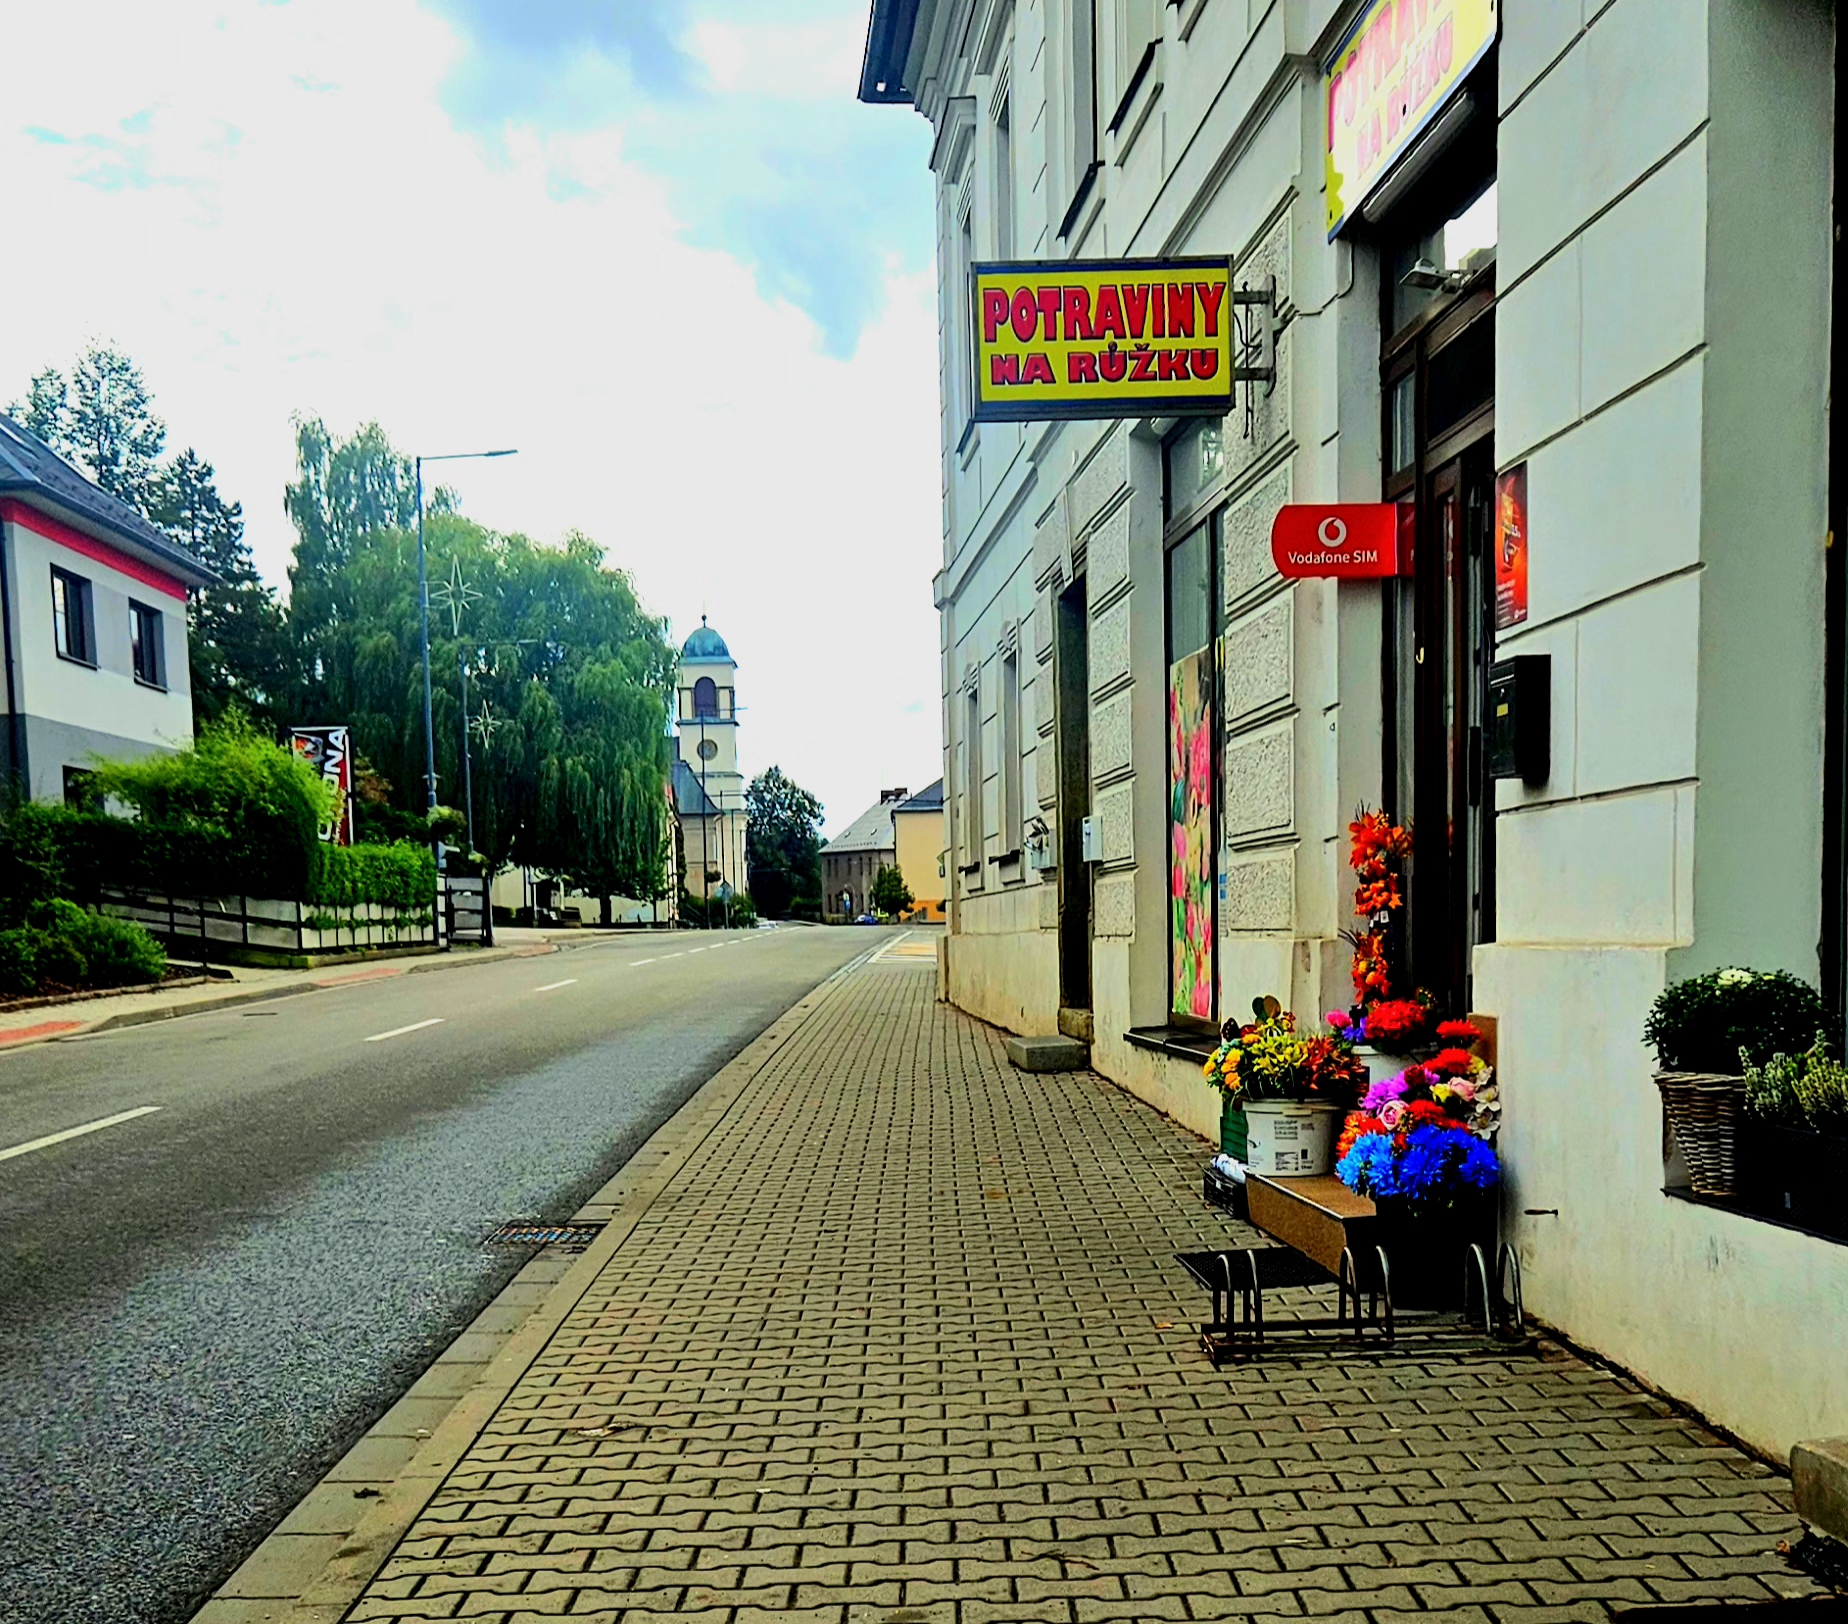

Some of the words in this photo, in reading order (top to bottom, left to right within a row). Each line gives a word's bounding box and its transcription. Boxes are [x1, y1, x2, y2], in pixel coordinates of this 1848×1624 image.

[983, 282, 1226, 343] POTRAVINY
[991, 353, 1056, 385] NA
[1068, 341, 1219, 383] RŮŽKU
[1288, 550, 1350, 564] Vodafone
[1353, 549, 1378, 563] SIM
